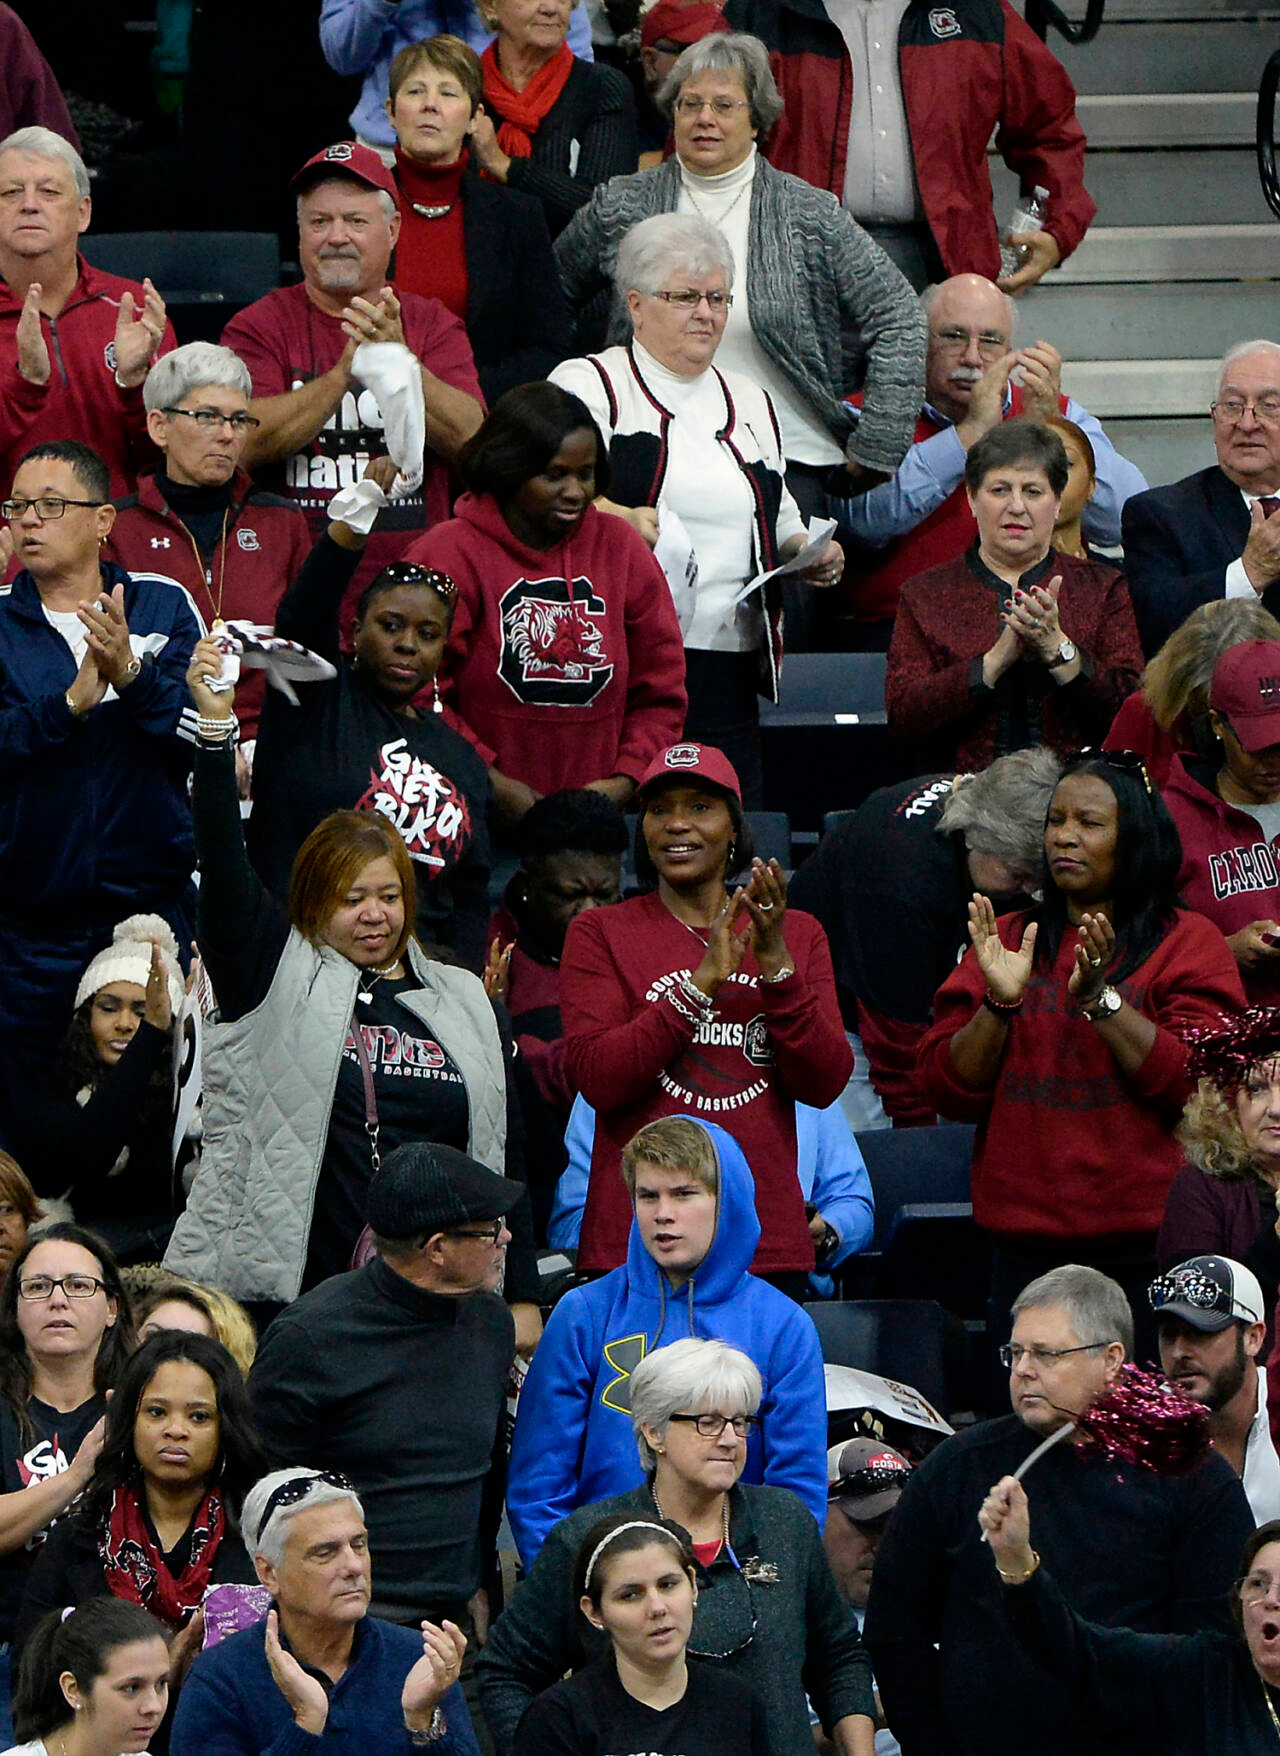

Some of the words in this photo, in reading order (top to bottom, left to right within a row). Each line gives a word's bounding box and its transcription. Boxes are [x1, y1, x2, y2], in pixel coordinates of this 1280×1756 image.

[286, 452, 370, 490] nati
[383, 1064, 464, 1084] BASKETBAL
[696, 1078, 769, 1112] BASKETBALL
